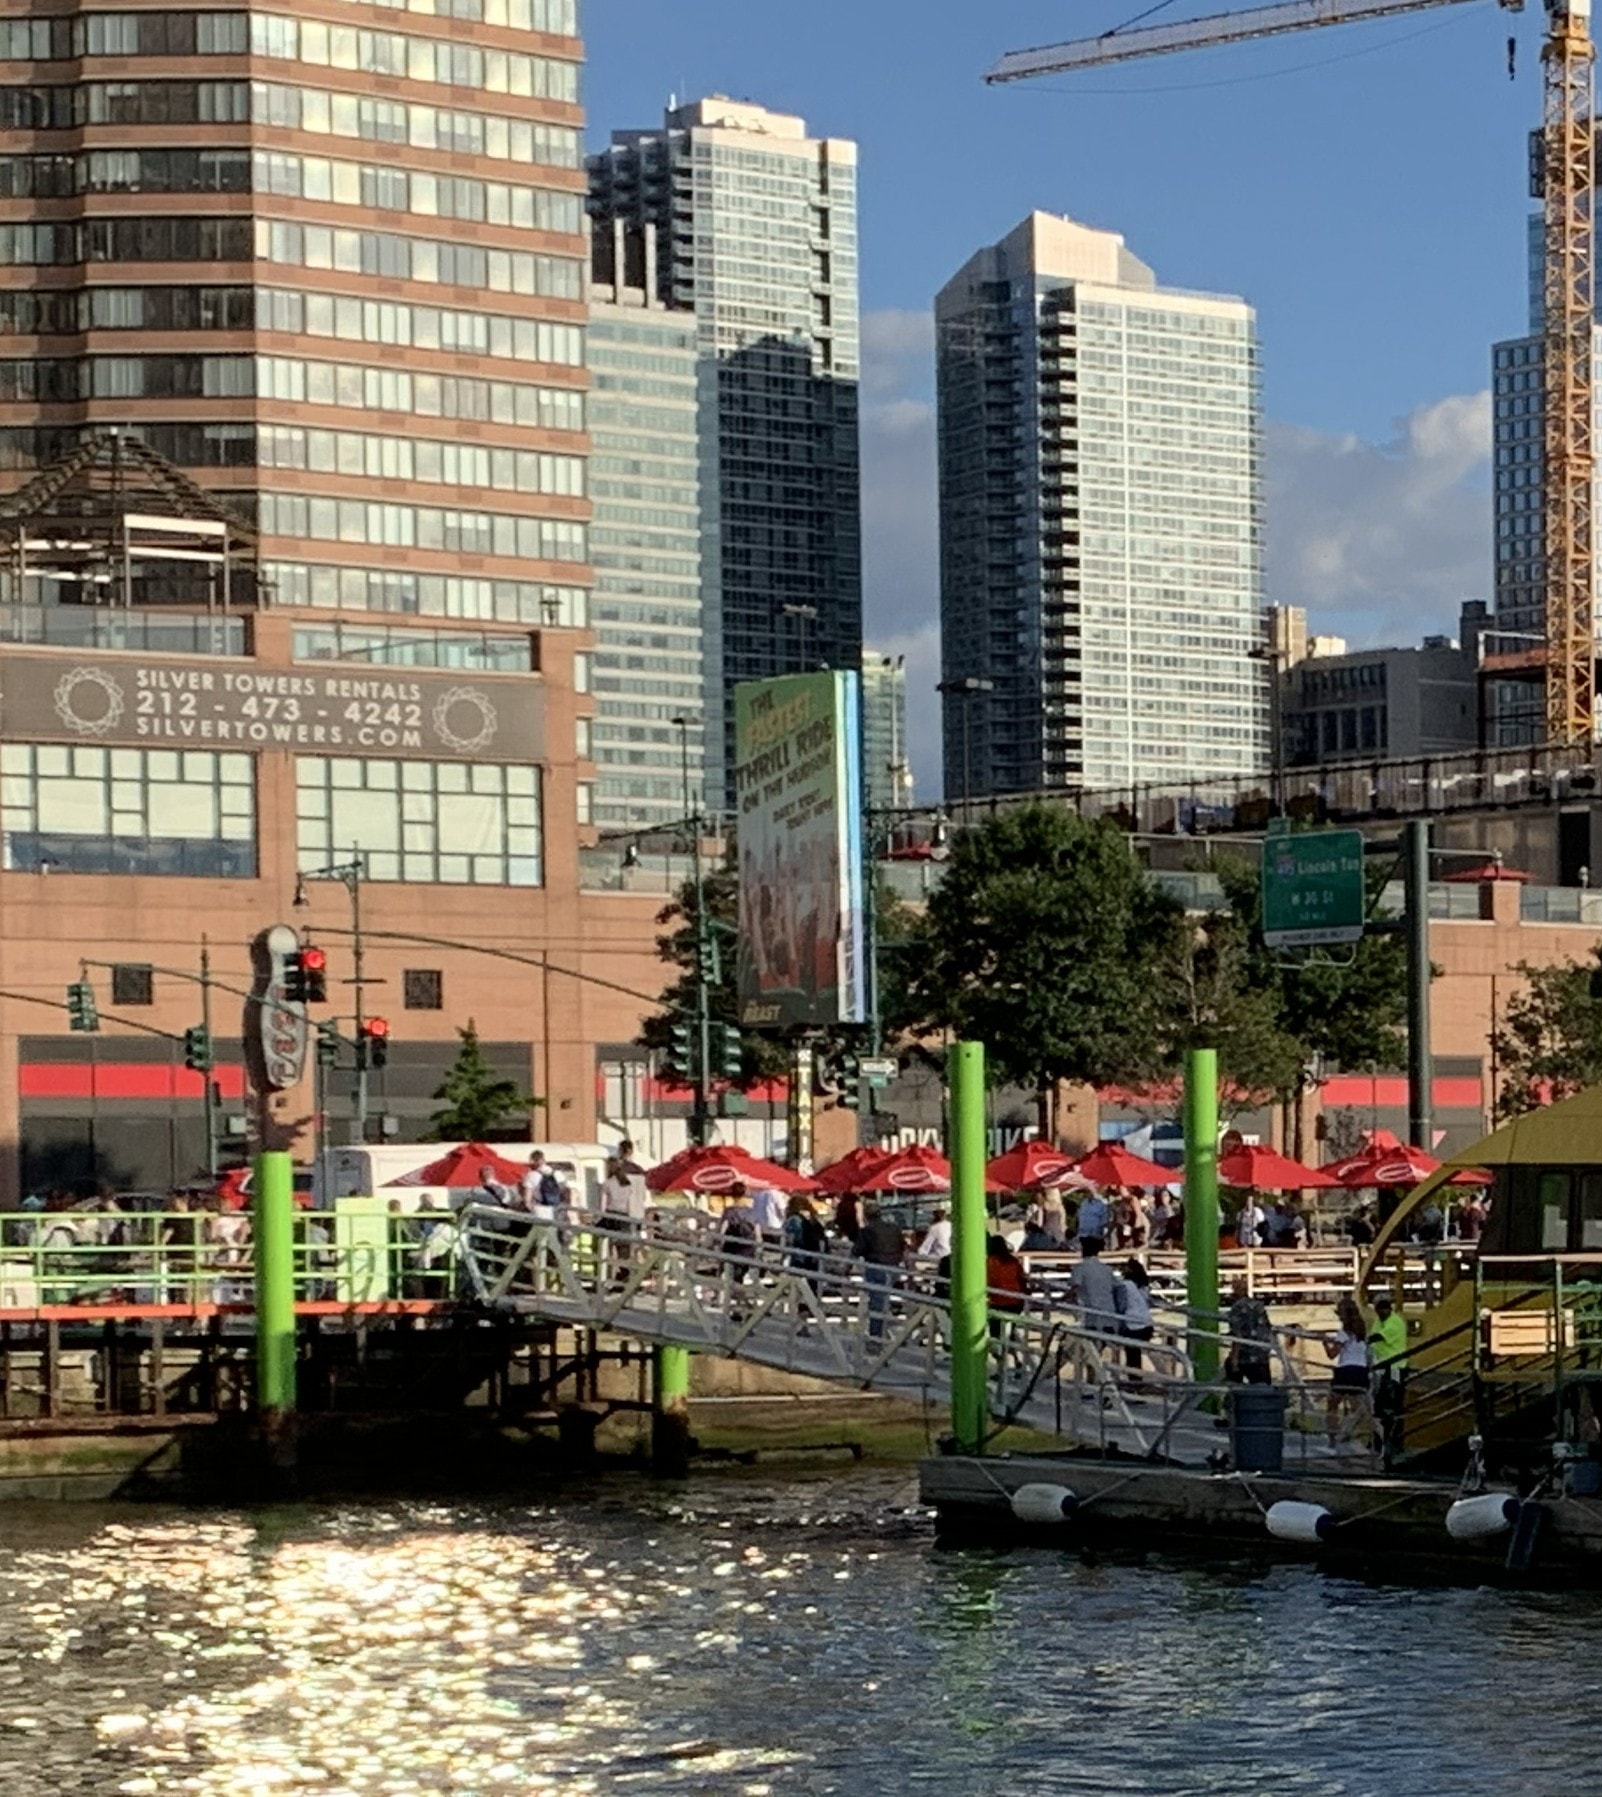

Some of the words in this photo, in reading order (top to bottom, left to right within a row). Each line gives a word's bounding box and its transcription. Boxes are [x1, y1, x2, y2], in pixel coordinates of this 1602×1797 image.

[136, 669, 214, 691] SILVER
[223, 674, 316, 696] TOWERS
[325, 679, 421, 701] RENTALS
[136, 690, 197, 716] 212
[241, 696, 301, 721] 473
[344, 701, 422, 727] 4242
[136, 717, 422, 748] SILVERTOWERS.COM
[735, 741, 790, 792] THRILL
[796, 714, 833, 757] RIDE
